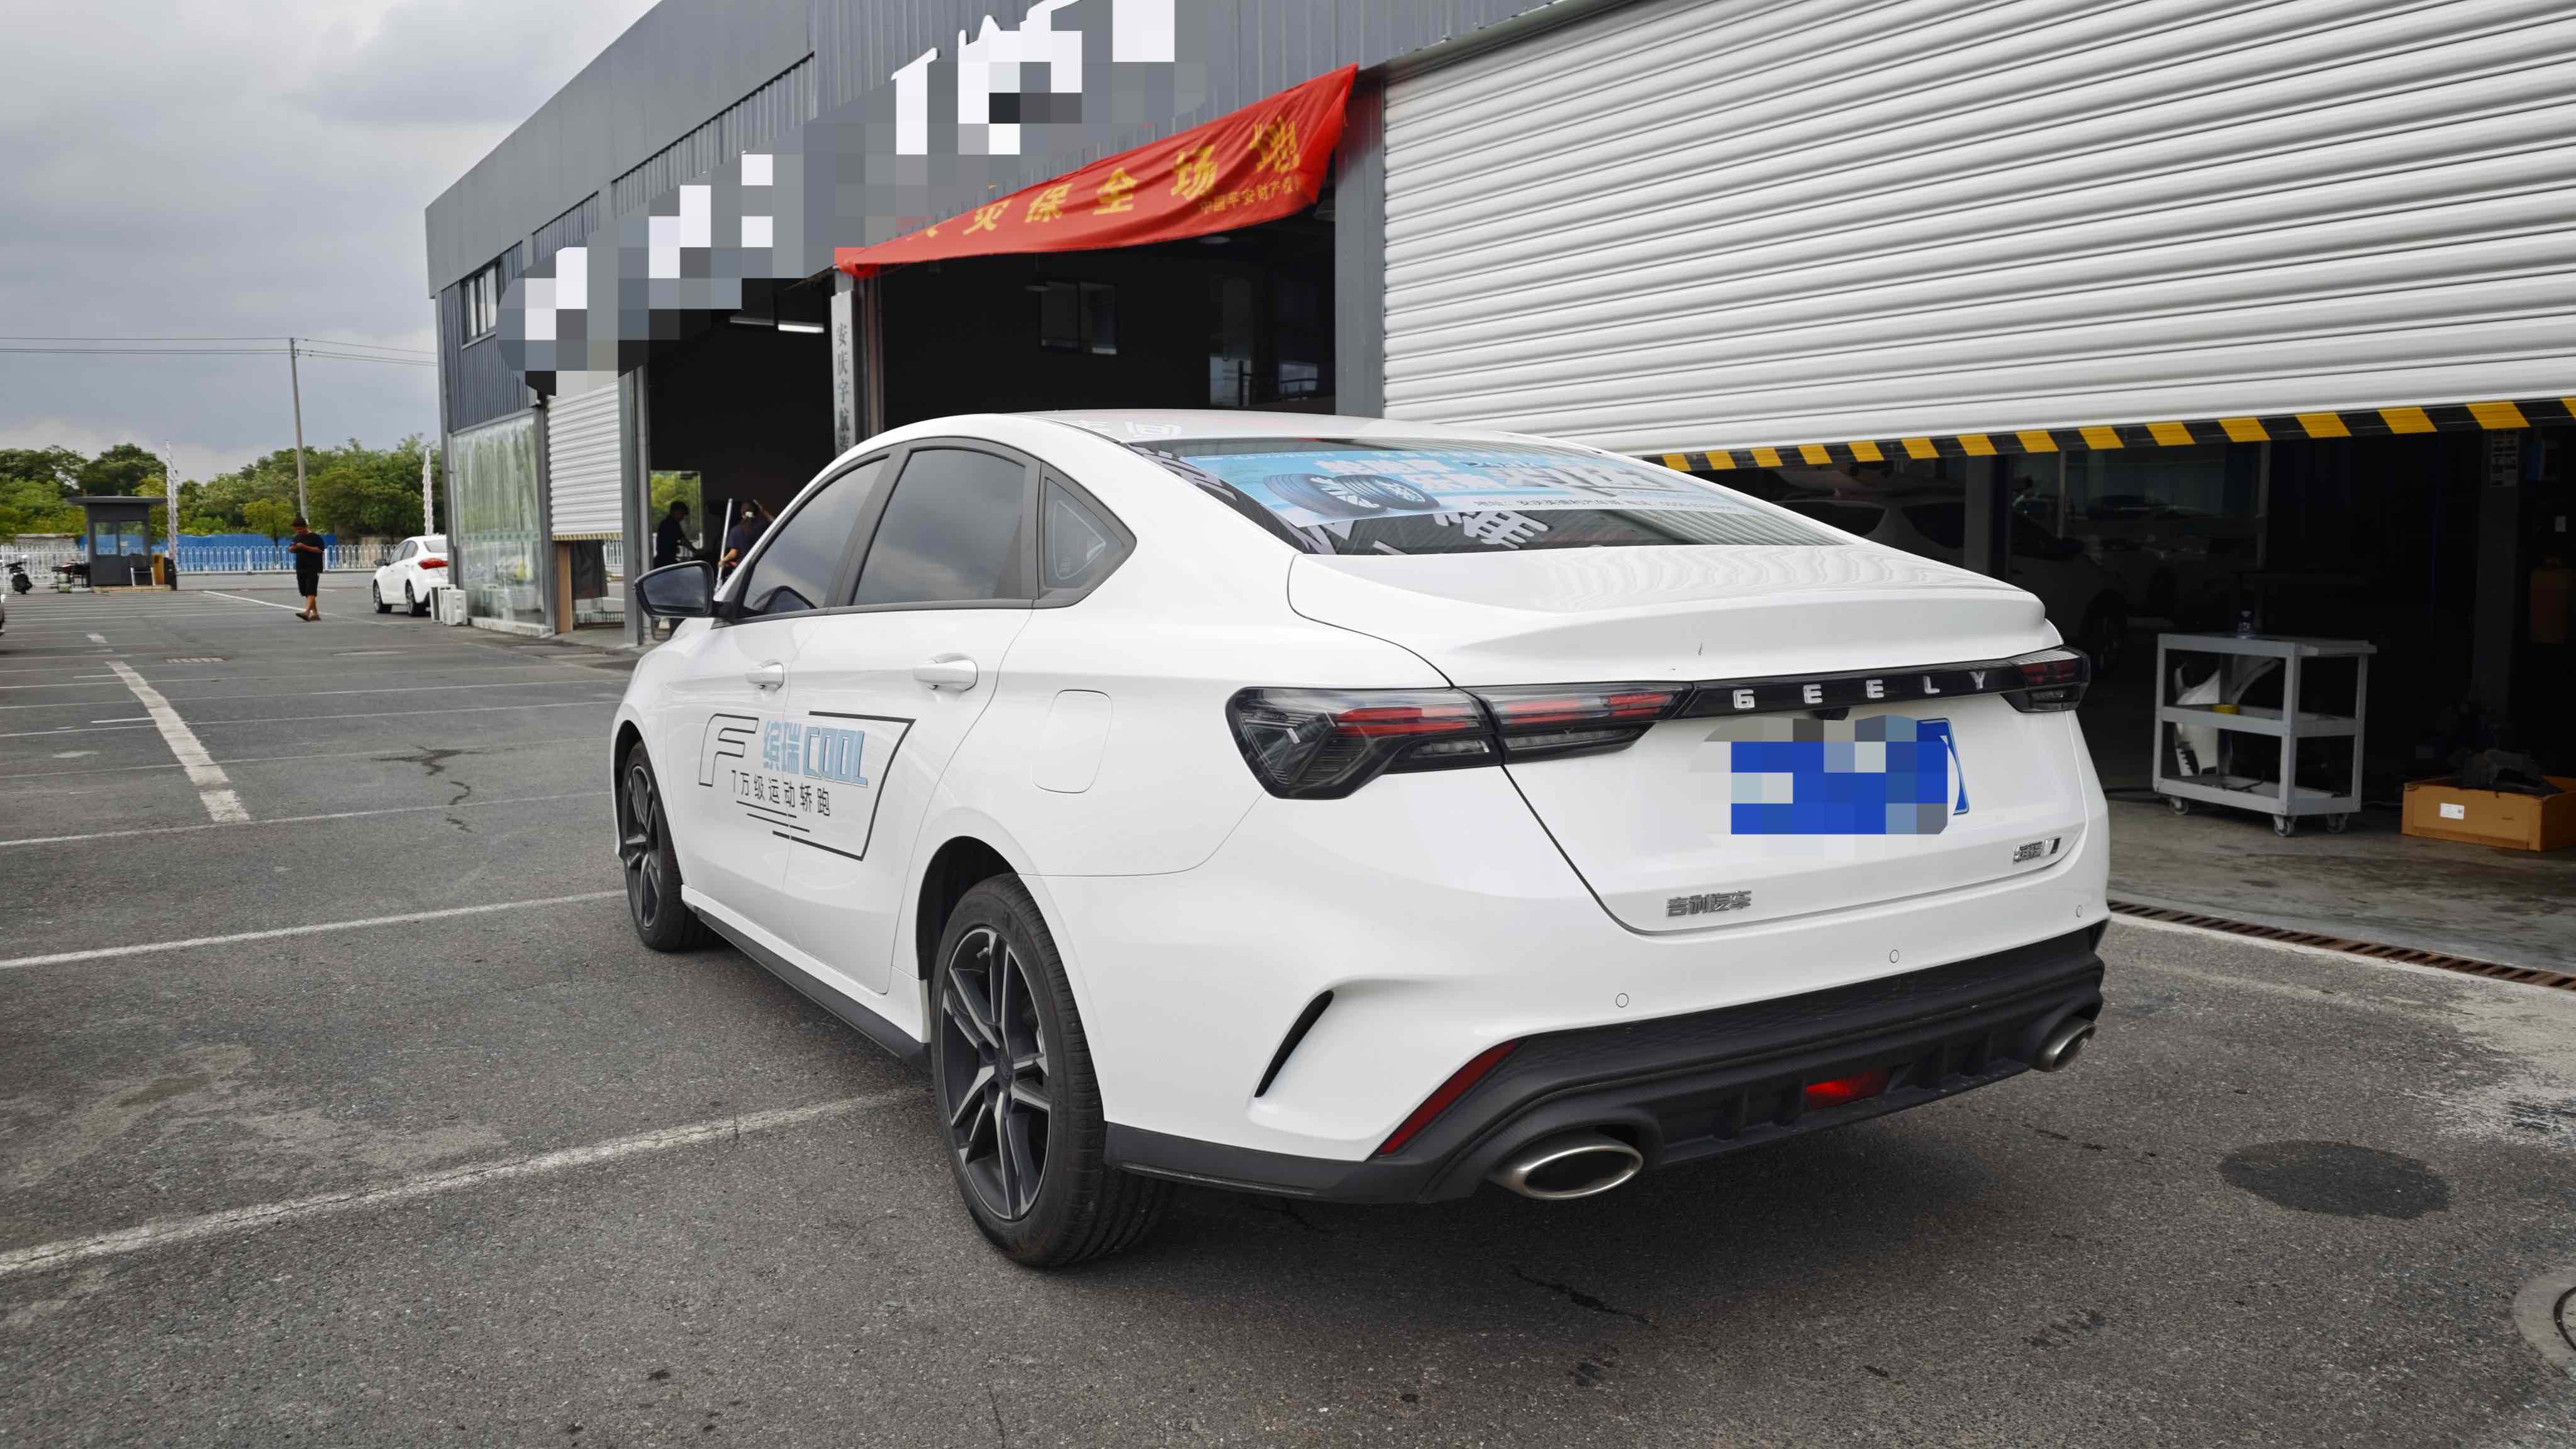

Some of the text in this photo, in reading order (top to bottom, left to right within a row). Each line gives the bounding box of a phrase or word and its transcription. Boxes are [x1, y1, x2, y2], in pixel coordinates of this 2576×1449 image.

[1734, 671, 1987, 709] GEELY
[731, 769, 830, 817] 7万级运动轿跑
[1666, 891, 1752, 917] 吉利汽车
